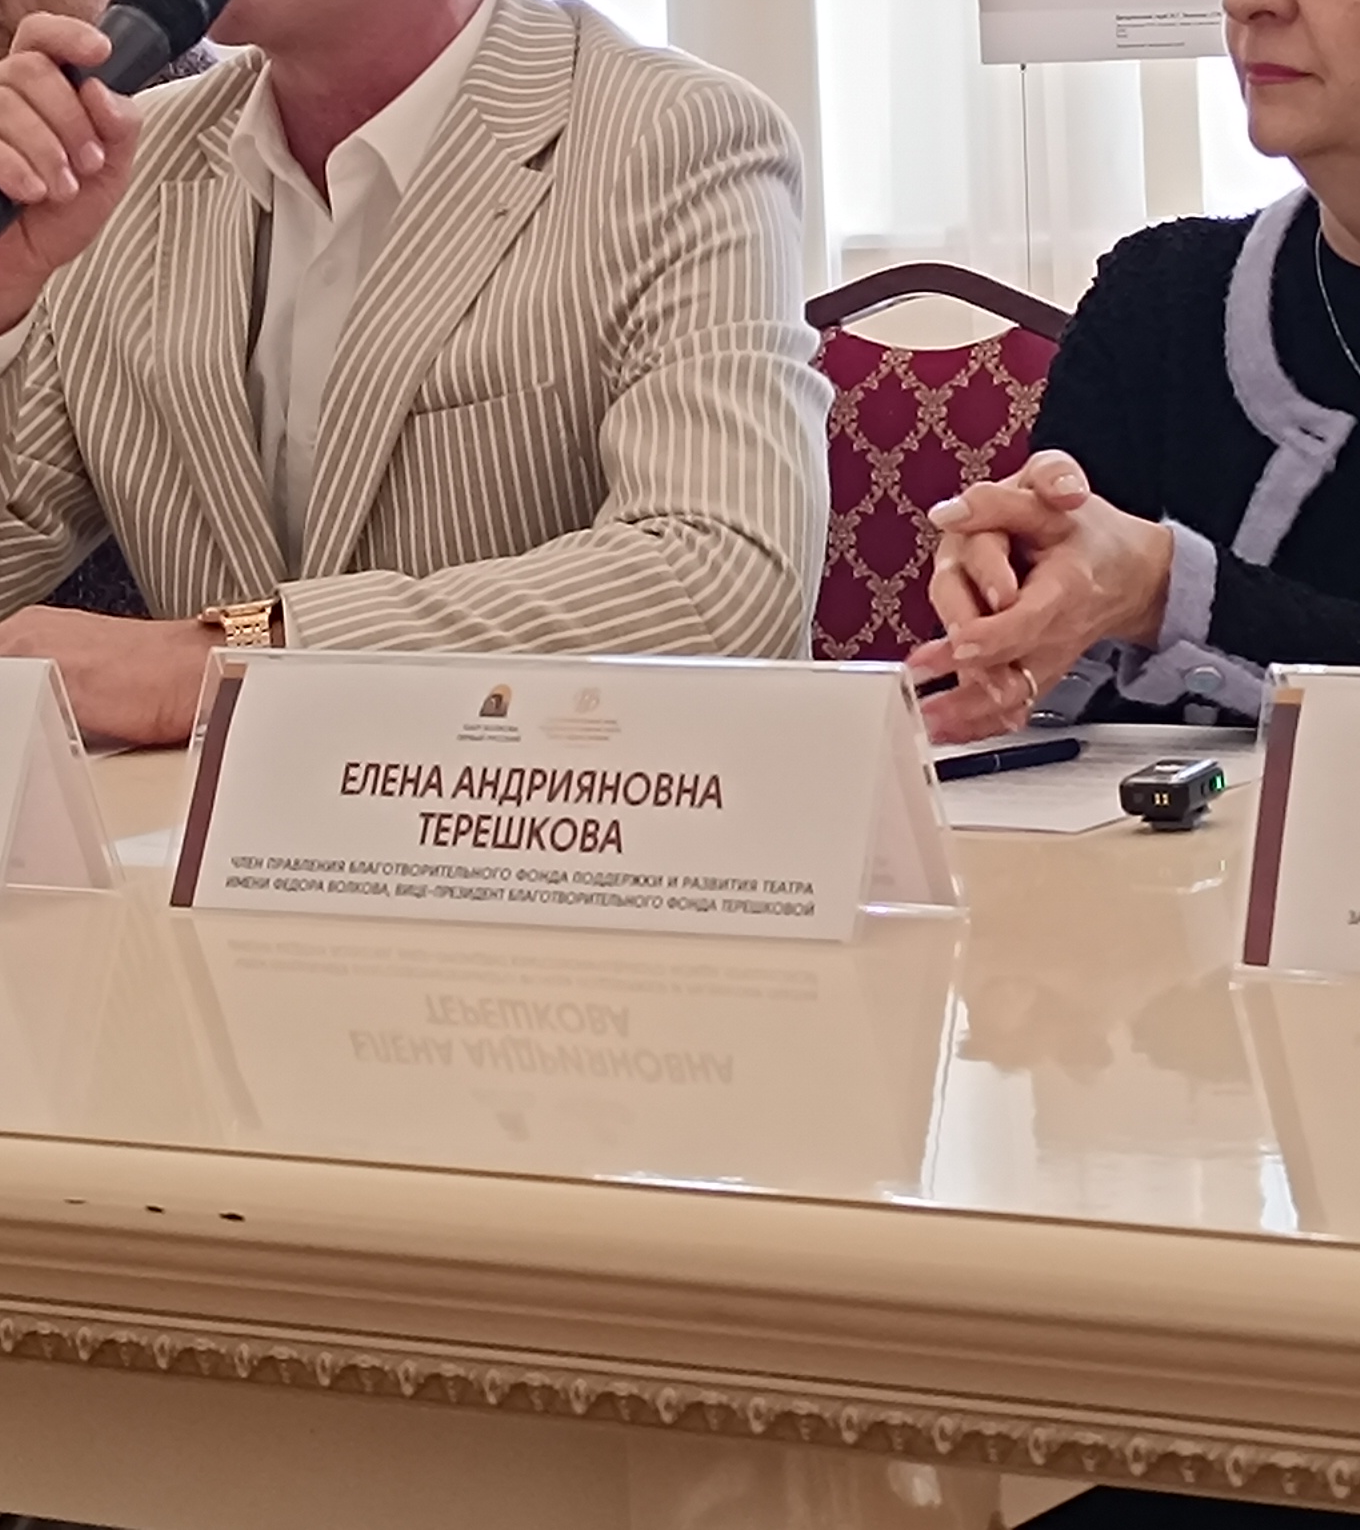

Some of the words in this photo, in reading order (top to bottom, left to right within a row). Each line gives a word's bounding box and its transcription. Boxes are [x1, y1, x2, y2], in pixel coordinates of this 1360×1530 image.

[340, 761, 443, 800] ЕЛЕНА
[451, 764, 723, 812] АНДРИЯНОВНА
[416, 811, 623, 855] ТЕРЕШКОВА
[225, 875, 270, 889] ИМЕНИ
[328, 880, 391, 898] ВОЛКОВА,
[394, 883, 505, 901] ВИЦЕ-ПРЕЗИДЕНТ
[508, 888, 663, 909] БЛАГОТВОРИТЕЛЬНОГО
[666, 896, 717, 912] ФОНДА
[721, 898, 815, 916] ТЕРЕШКОВОЙ
[230, 856, 264, 869] ЧЛЕН
[266, 857, 345, 873] ПРАВЛЕНИЯ
[348, 861, 512, 881] БЛАГОТВОРИТЕЛЬНОГО
[516, 868, 569, 885] ФОНДА
[572, 871, 663, 888] ПОДДЕРЖКИ
[667, 875, 679, 888] И
[681, 875, 759, 892] РАЗВИТИЯ
[762, 879, 814, 895] ТЕАТРА
